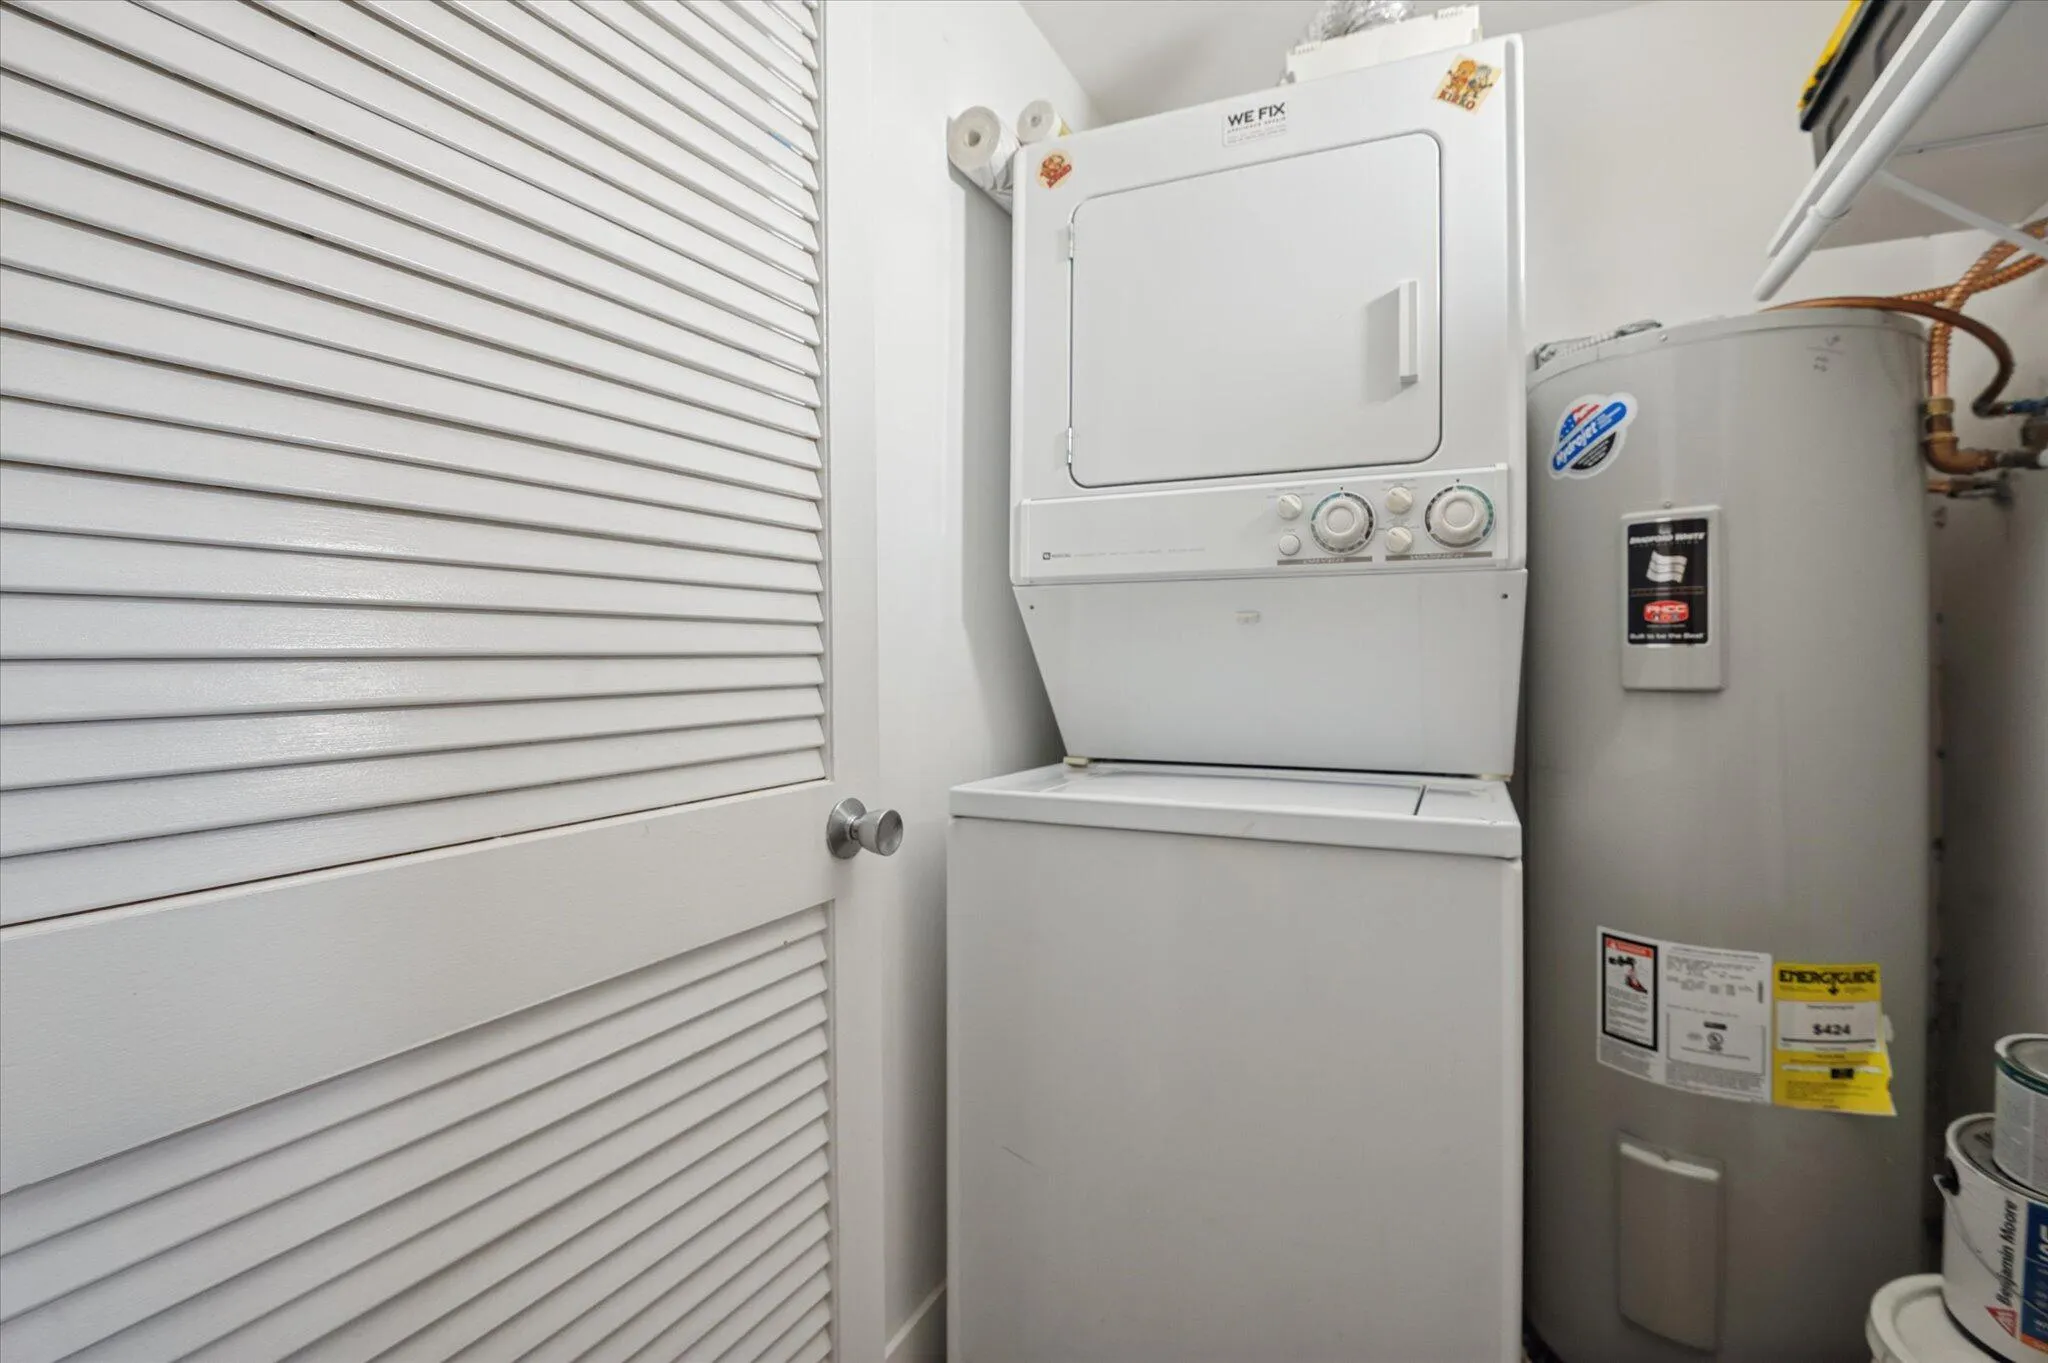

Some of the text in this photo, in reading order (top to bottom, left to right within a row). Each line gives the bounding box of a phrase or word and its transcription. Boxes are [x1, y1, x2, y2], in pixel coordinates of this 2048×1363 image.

[1227, 102, 1286, 127] WE FIX
[1812, 1023, 1851, 1036] $424
[1996, 1198, 2018, 1307] Benjamin Moore
